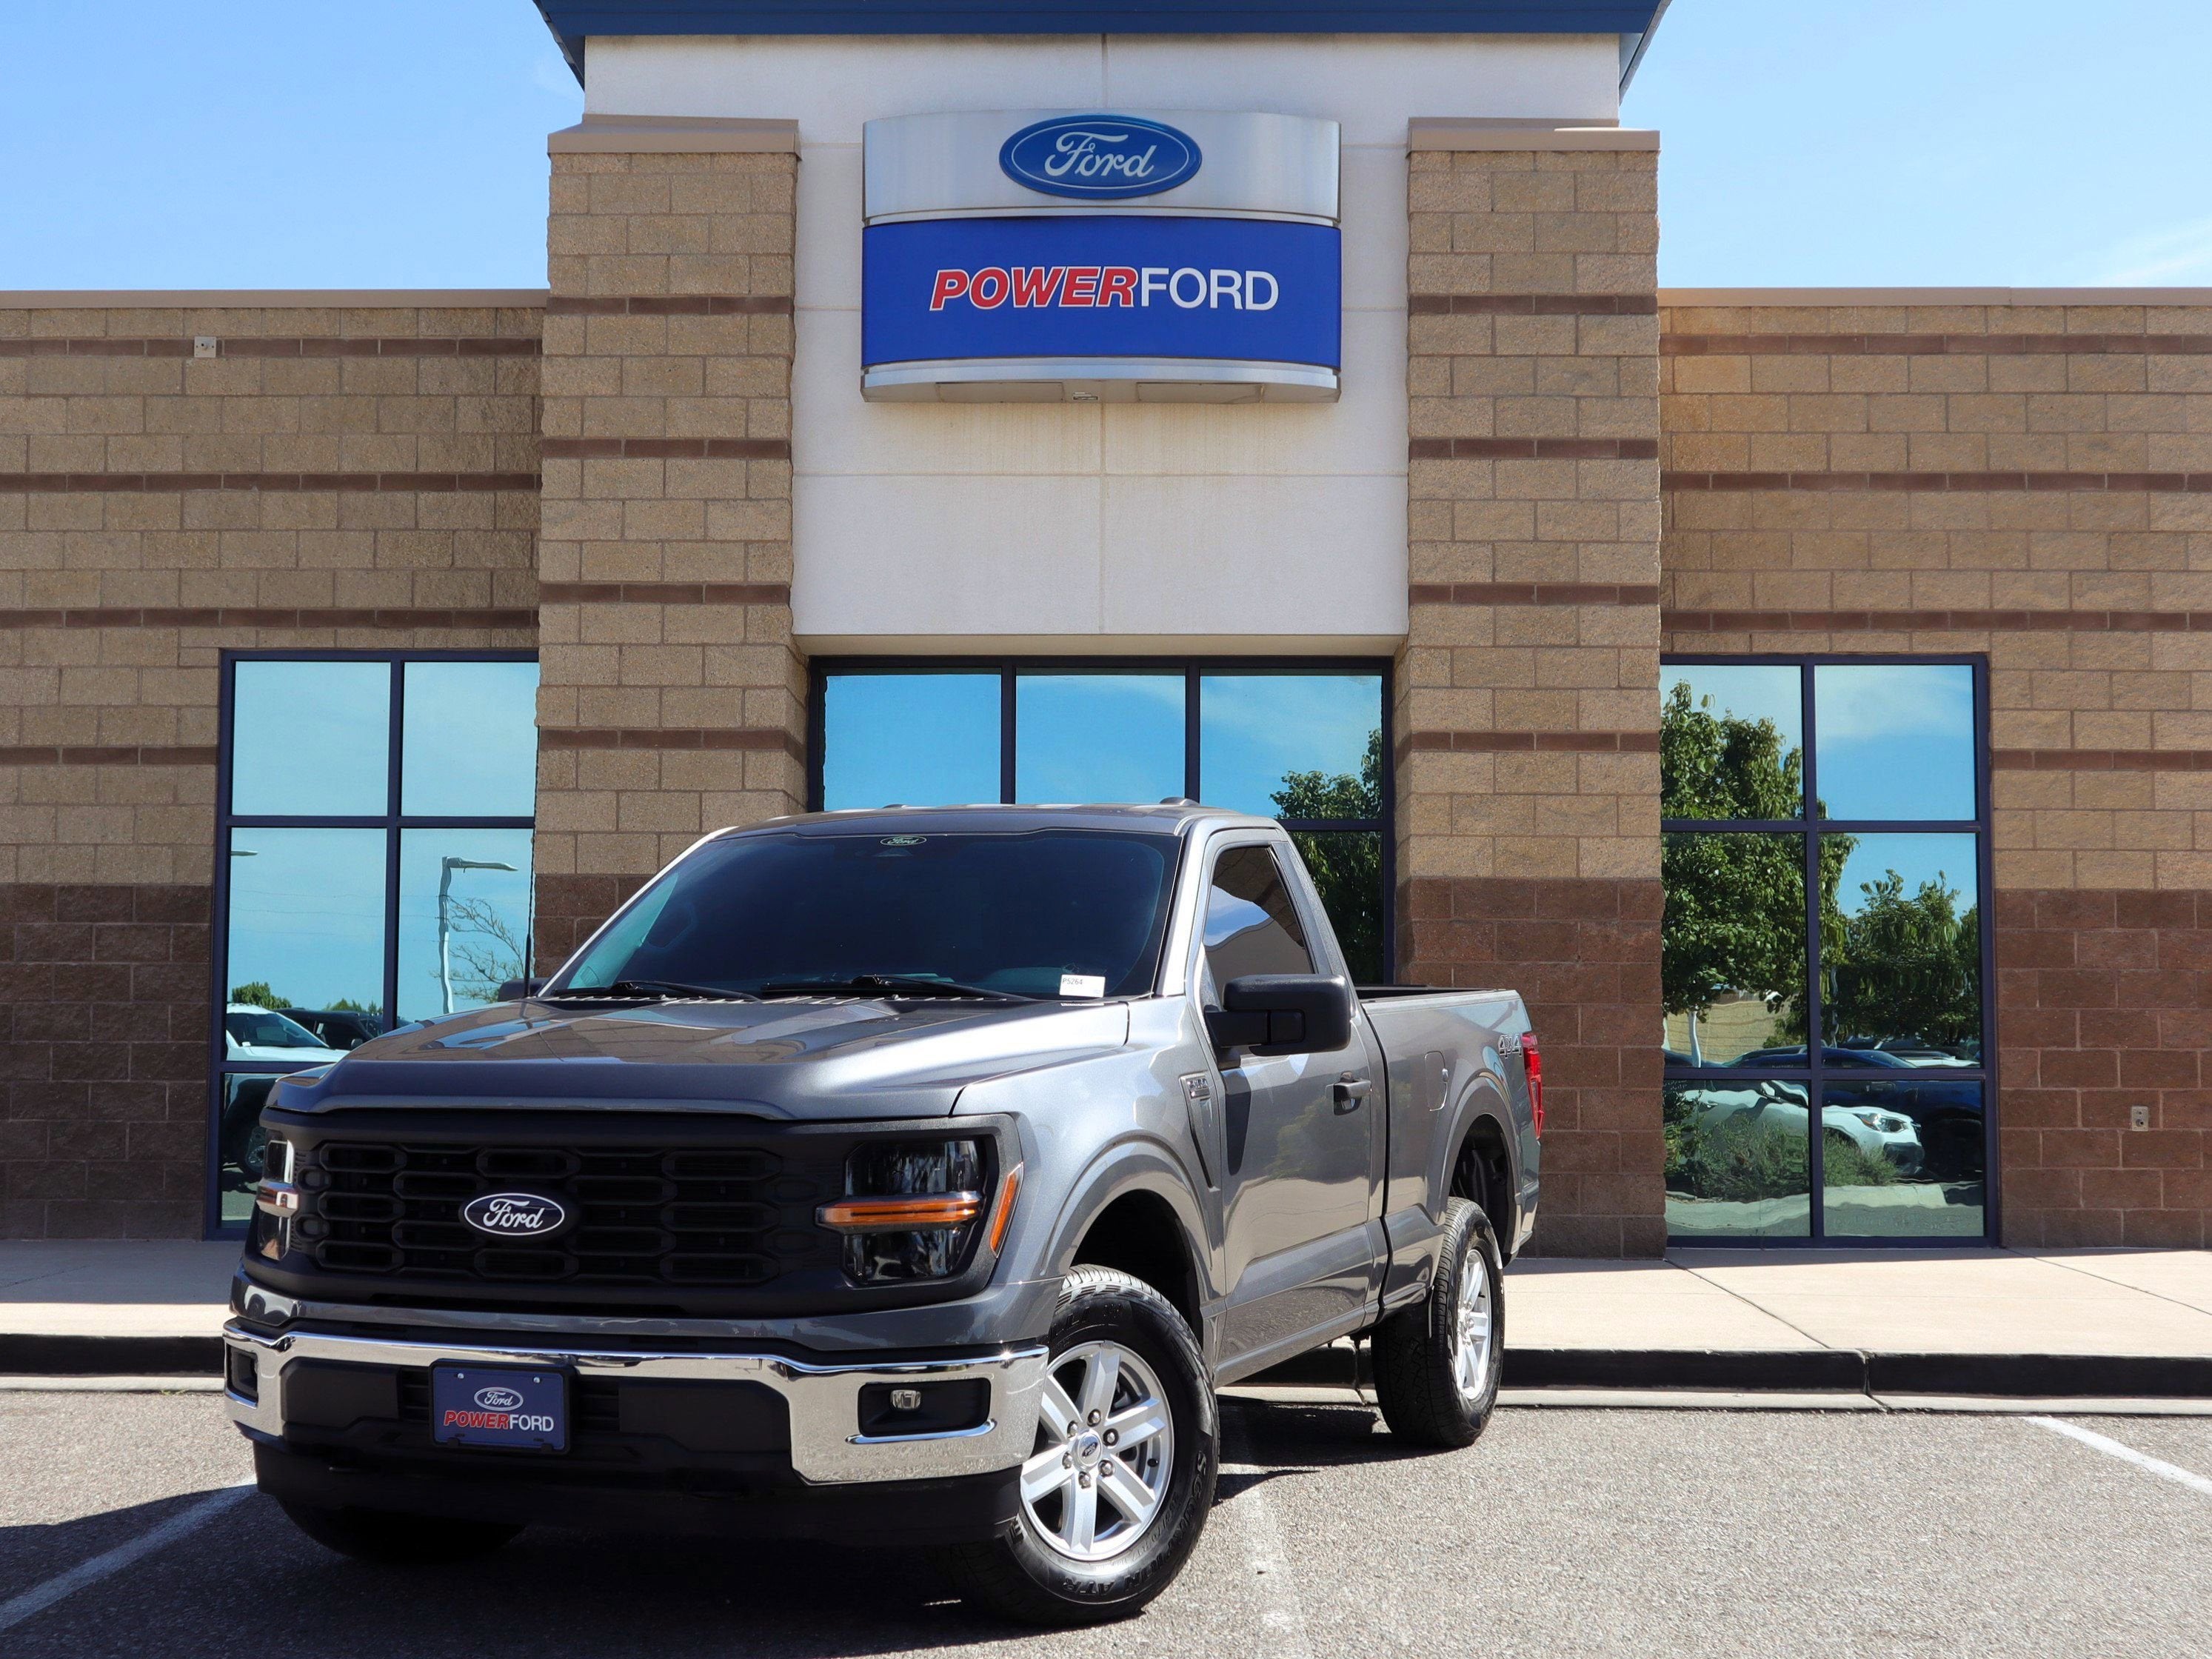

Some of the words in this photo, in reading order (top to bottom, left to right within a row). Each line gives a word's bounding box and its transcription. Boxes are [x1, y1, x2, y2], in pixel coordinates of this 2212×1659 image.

[1043, 130, 1157, 178] Ford
[929, 266, 1280, 311] POWERFORD
[887, 836, 920, 844] Ford
[482, 1198, 544, 1229] Ford
[484, 1391, 514, 1406] Ford
[444, 1410, 555, 1432] POWERFORD
